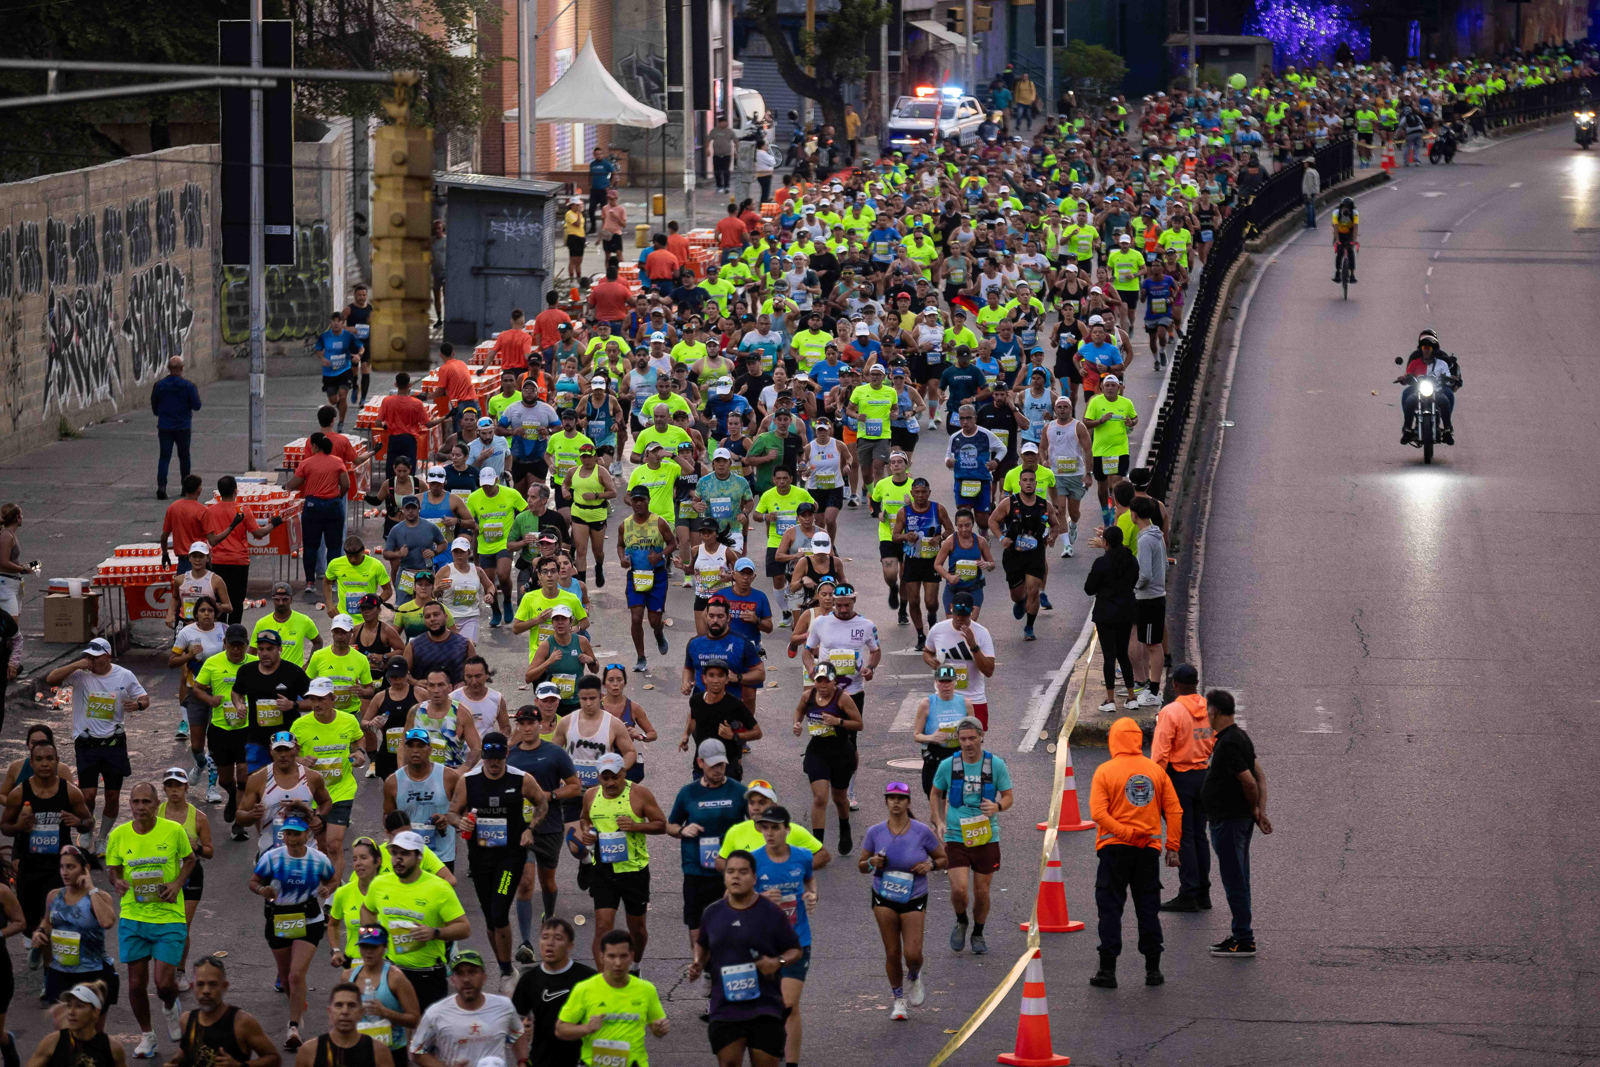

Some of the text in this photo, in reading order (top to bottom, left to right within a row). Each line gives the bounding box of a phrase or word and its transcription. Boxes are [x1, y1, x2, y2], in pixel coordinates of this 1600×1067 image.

[851, 629, 864, 638] LPG
[90, 702, 115, 711] 4743
[259, 711, 282, 719] 3130
[479, 831, 505, 839] 1943
[965, 826, 989, 838] 2611
[31, 836, 58, 844] 1089
[600, 844, 625, 853] 1429
[134, 884, 157, 893] 428
[882, 881, 909, 894] 1234
[276, 919, 305, 930] 4575
[52, 943, 78, 955] 3952
[726, 978, 756, 991] 1252
[593, 1056, 626, 1067] 4051
